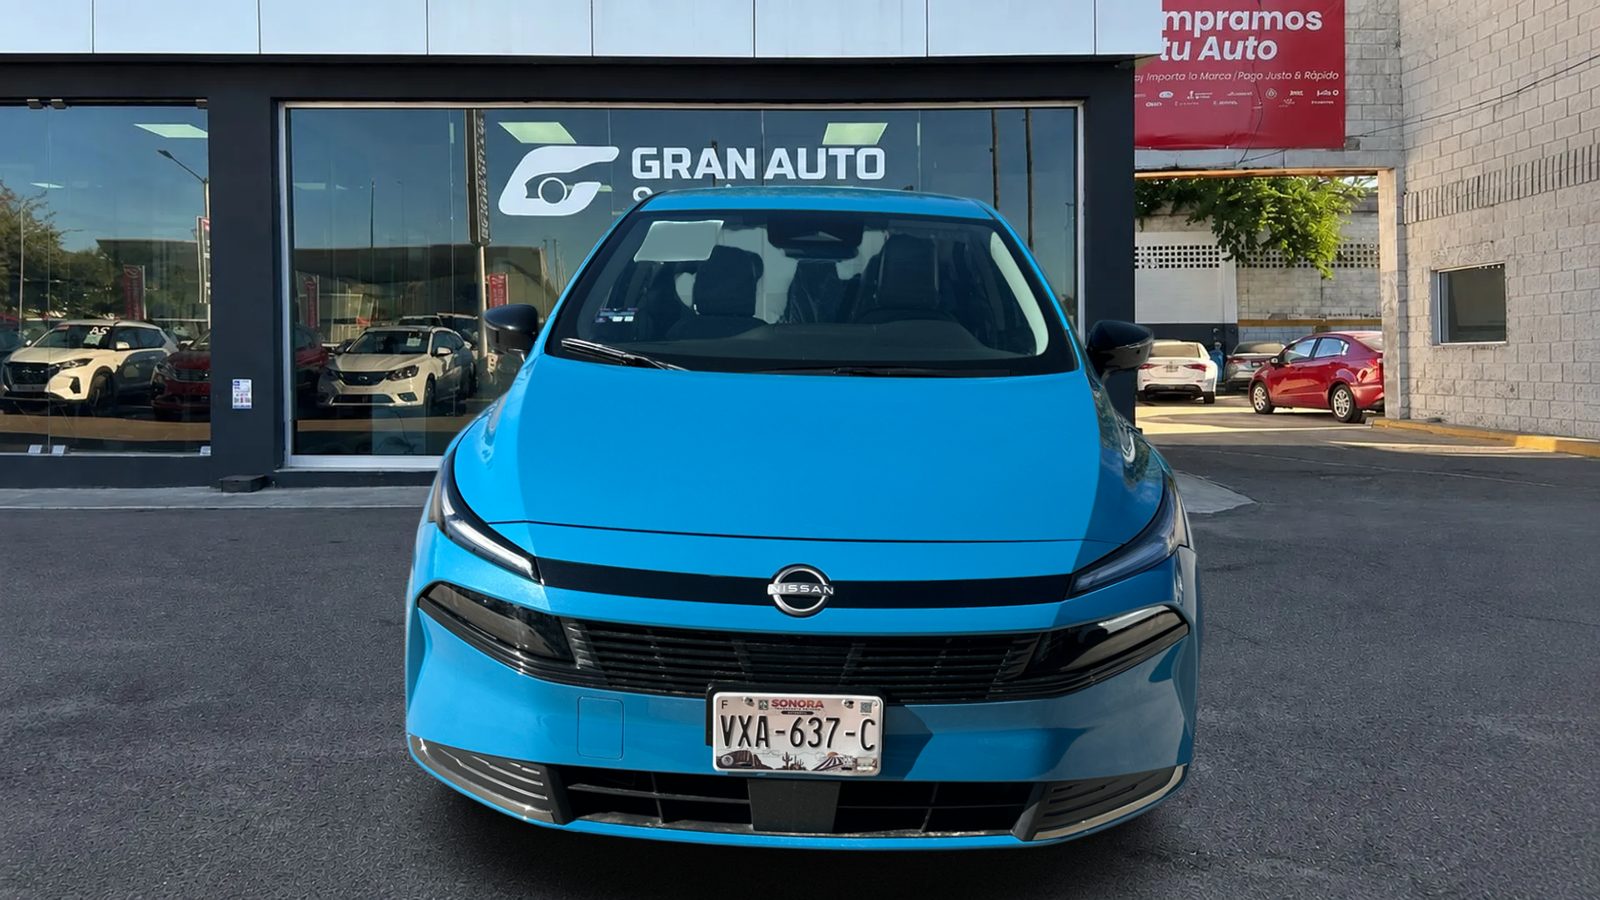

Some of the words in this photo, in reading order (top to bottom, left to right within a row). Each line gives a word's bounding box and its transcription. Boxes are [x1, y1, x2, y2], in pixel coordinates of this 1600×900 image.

[1161, 10, 1323, 38] mpramos
[1160, 37, 1191, 61] tu
[1197, 36, 1278, 61] Auto
[1146, 73, 1186, 83] Importa
[1188, 72, 1198, 81] la
[1199, 72, 1232, 81] Marca
[1265, 72, 1292, 80] Justo
[1294, 71, 1302, 80] &
[631, 146, 756, 180] GRAN
[763, 147, 886, 180] AUTO
[767, 584, 834, 595] NISSAN
[721, 700, 729, 709] F
[771, 699, 825, 708] SONORA
[719, 714, 876, 751] VXA-637-C
